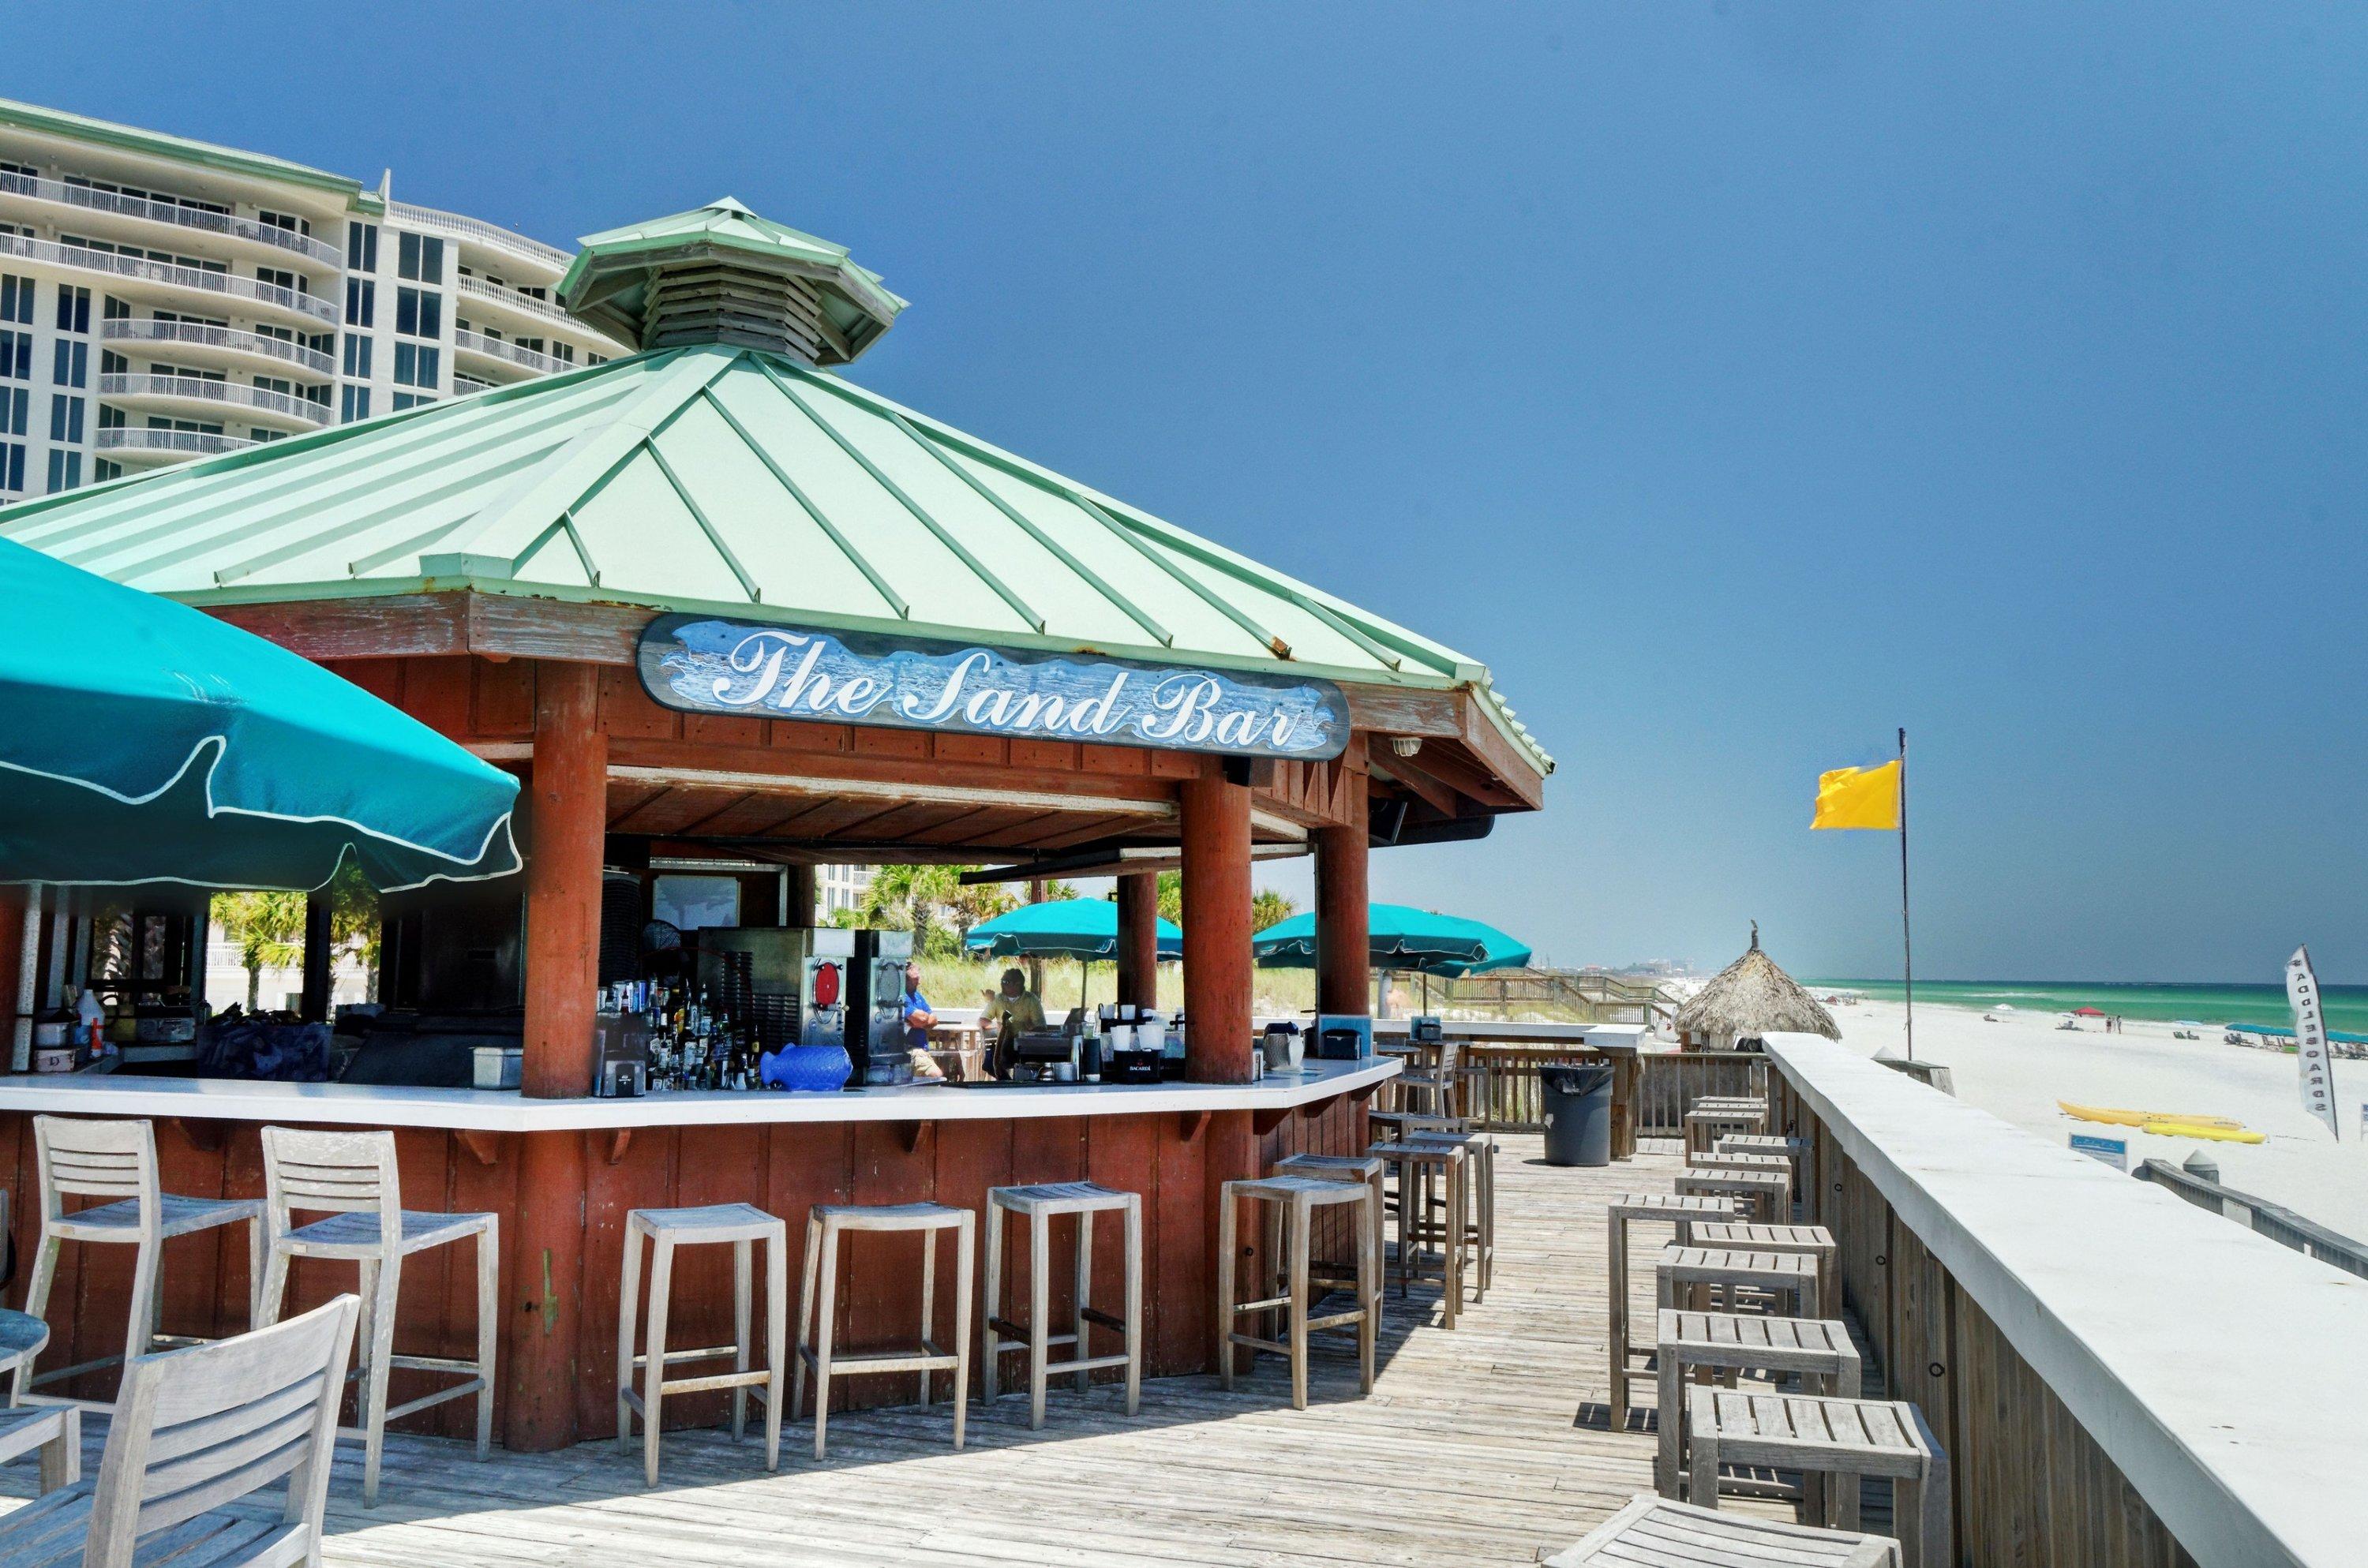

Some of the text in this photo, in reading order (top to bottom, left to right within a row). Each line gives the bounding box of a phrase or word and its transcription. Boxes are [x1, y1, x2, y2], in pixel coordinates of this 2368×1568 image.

[712, 631, 1302, 747] The Sand Bar
